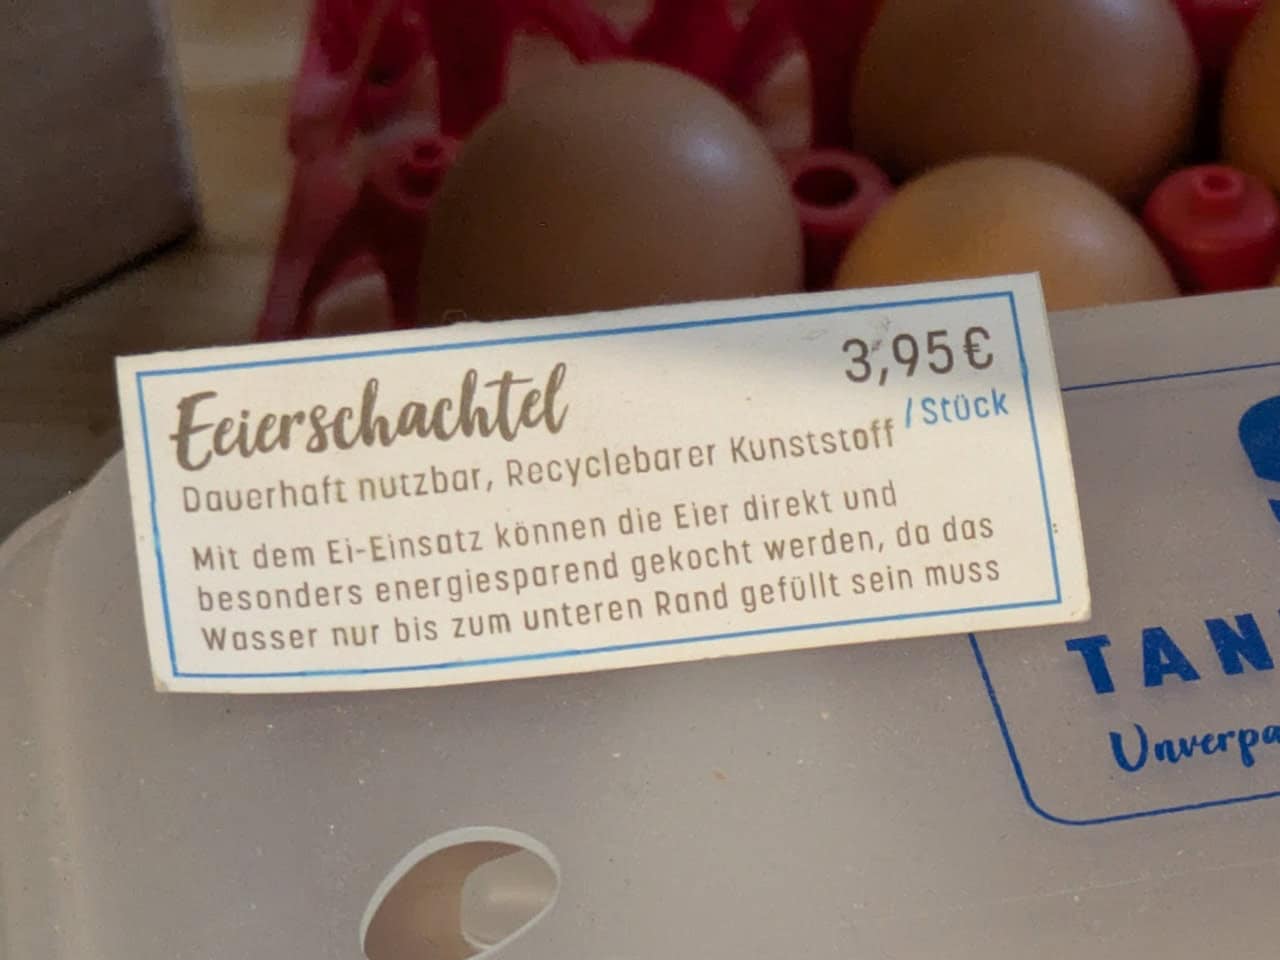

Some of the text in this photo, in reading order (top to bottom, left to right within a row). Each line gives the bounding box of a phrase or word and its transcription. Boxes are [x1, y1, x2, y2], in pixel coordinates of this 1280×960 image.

[842, 325, 994, 387] 3,95€
[182, 418, 894, 513] Dauerhaft nutzbar, Recyclebarer Kunststoff
[192, 480, 897, 571] Mit dem Ei-Einsatz können die Eier direkt und
[198, 516, 994, 612] besonders energiesparend gekocht werden, da das
[201, 560, 1000, 651] Wasser nur bis zum unteren Rand gefüllt sein muss
